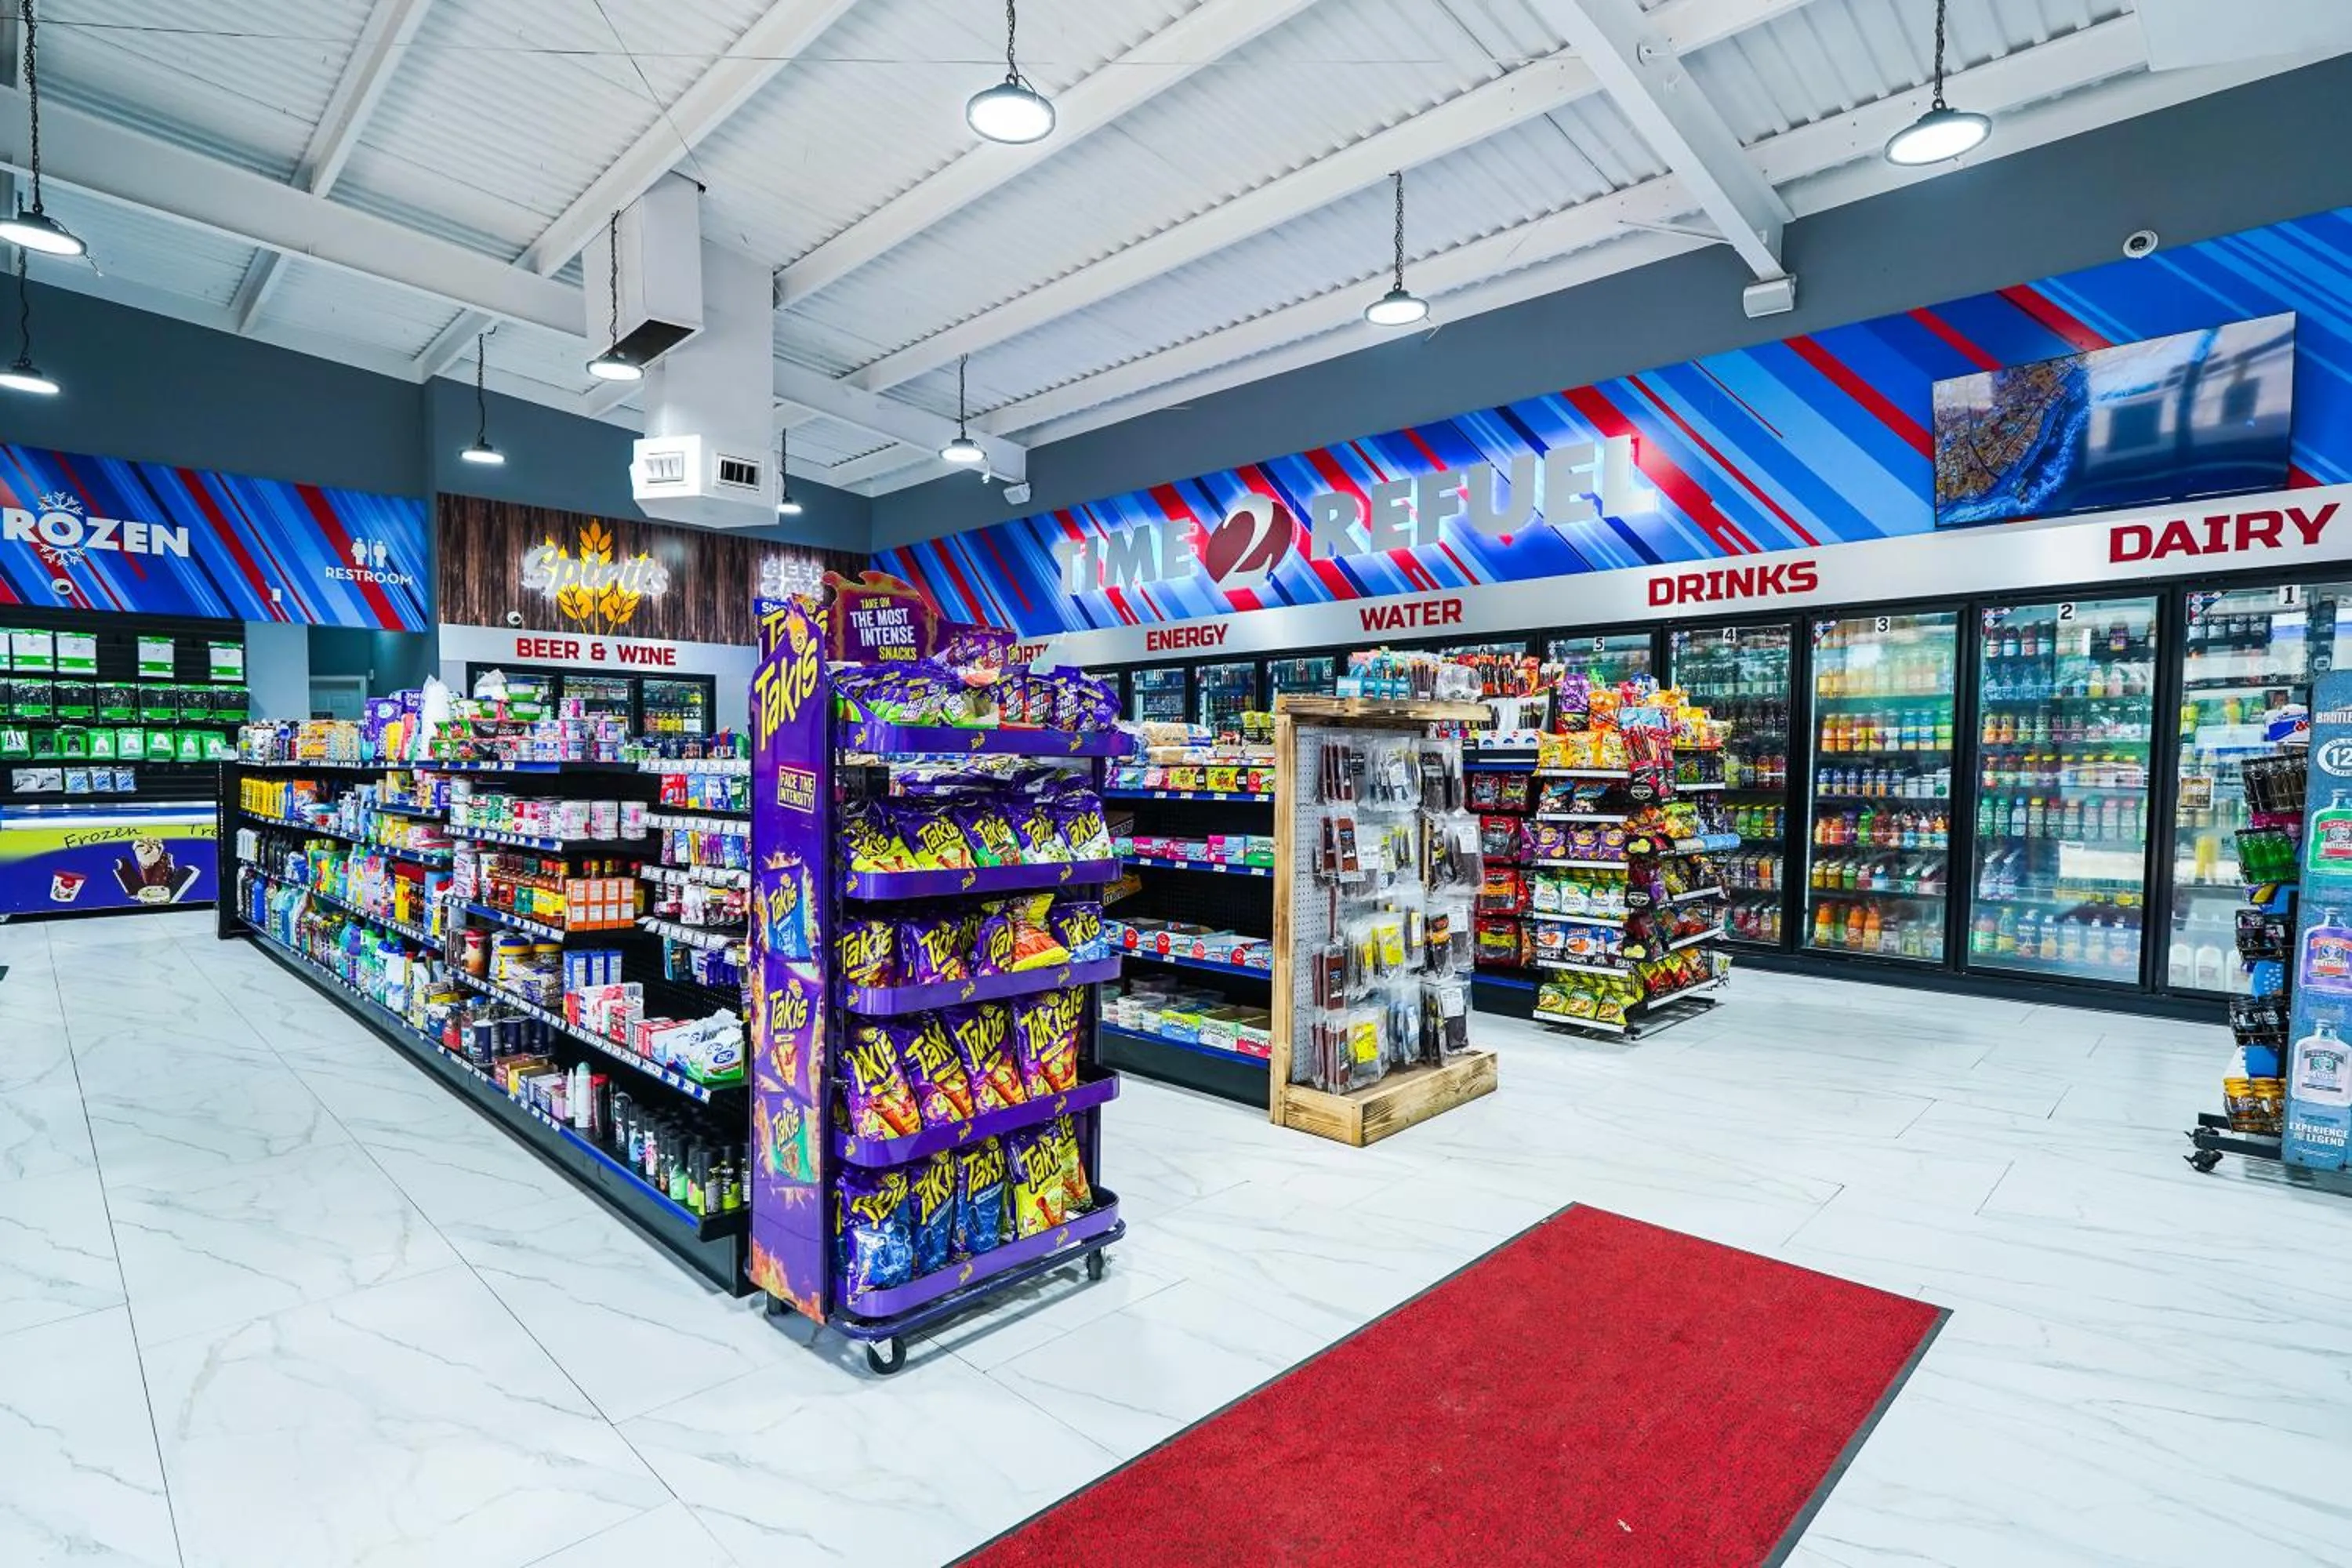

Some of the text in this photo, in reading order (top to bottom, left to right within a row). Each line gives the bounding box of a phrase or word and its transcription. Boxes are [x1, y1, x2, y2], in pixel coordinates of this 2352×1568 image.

[1054, 517, 1194, 595] TIME
[1312, 434, 1656, 562] REFUEL
[2109, 503, 2340, 564] DAIRY
[325, 566, 413, 586] RESTROOM
[523, 544, 668, 597] Spirits
[1648, 561, 1819, 607] DRINKS
[860, 599, 879, 609] TAKE
[2284, 586, 2295, 604] 1
[850, 608, 909, 628] THE MOST
[1359, 598, 1463, 632] WATER
[1877, 617, 1889, 632] 3
[2060, 605, 2074, 620] 2
[860, 626, 915, 646] INTENSE
[1147, 623, 1229, 652] ENERGY
[1595, 637, 1603, 650] 5
[1724, 629, 1735, 642] 4
[517, 638, 677, 666] BEER & WINE
[879, 647, 916, 661] SNACKS
[754, 637, 818, 752] Takis
[779, 786, 814, 808] INTENSITY
[780, 772, 814, 793] FACE THE
[64, 826, 143, 849] Frozen
[918, 818, 960, 855] Takis
[973, 818, 1013, 853] Takis
[768, 881, 798, 929] Takis
[1059, 913, 1101, 950] Takis
[836, 924, 894, 975] Takis
[769, 989, 808, 1036] Takis
[905, 1022, 956, 1080] Tak
[956, 1009, 1006, 1071] Takis
[771, 1107, 800, 1152] Takis
[2288, 1122, 2350, 1140] EXPERIENCE
[2307, 1133, 2345, 1147] LEGEND
[1020, 1142, 1062, 1194] Taki
